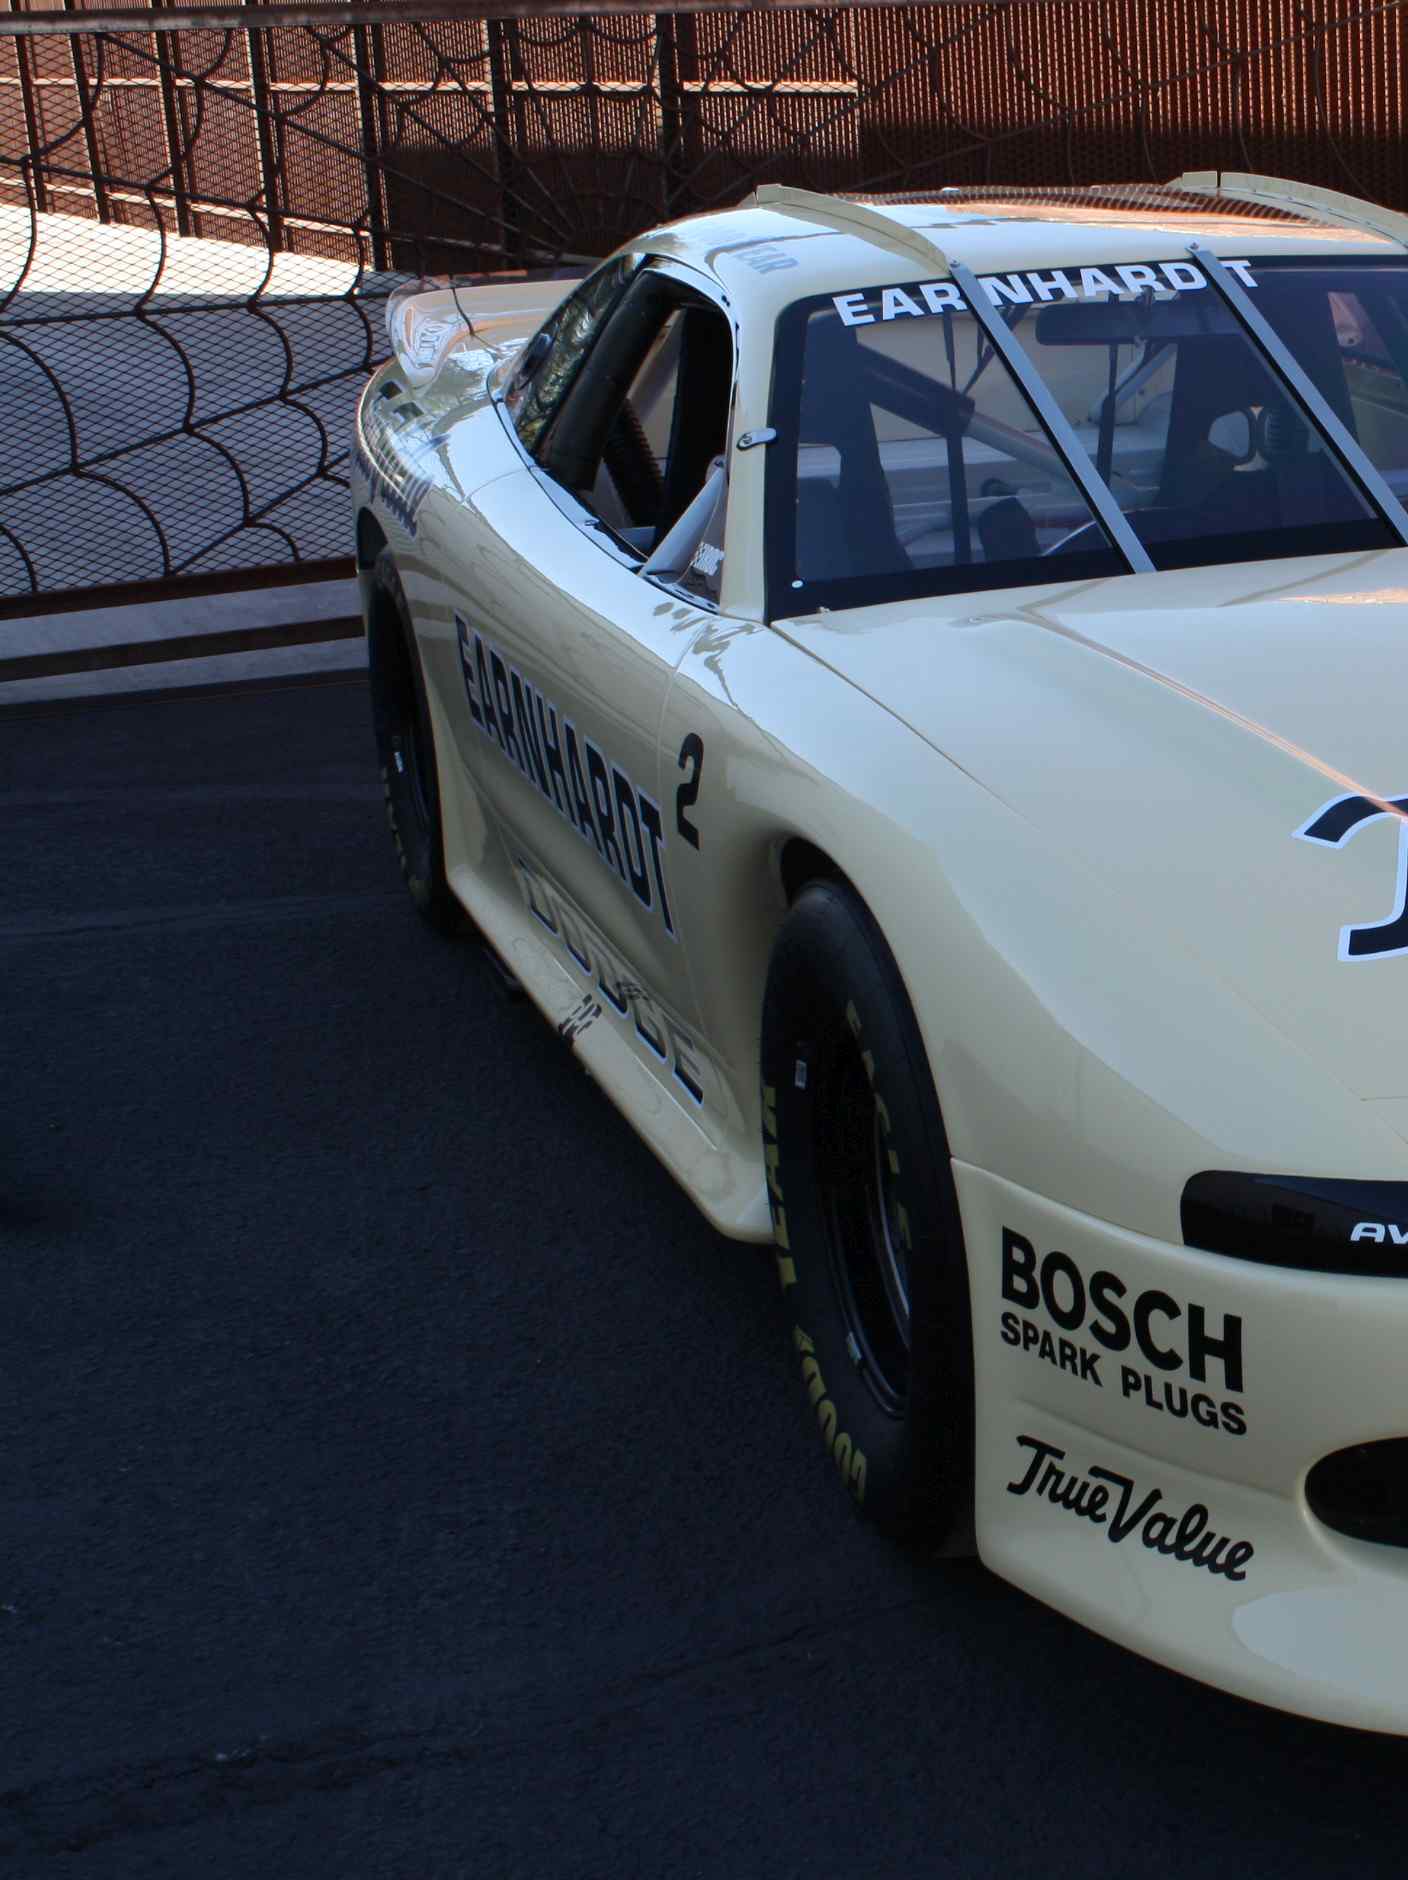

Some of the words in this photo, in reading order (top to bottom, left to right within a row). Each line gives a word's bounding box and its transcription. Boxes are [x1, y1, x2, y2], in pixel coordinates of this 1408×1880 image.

[832, 259, 1258, 327] EARNHARDT
[455, 608, 681, 944] EARNHARDT
[676, 732, 704, 852] 2
[1001, 1225, 1244, 1394] BOSCH
[1001, 1310, 1103, 1387] SPARK
[1121, 1363, 1248, 1436] PLUGS
